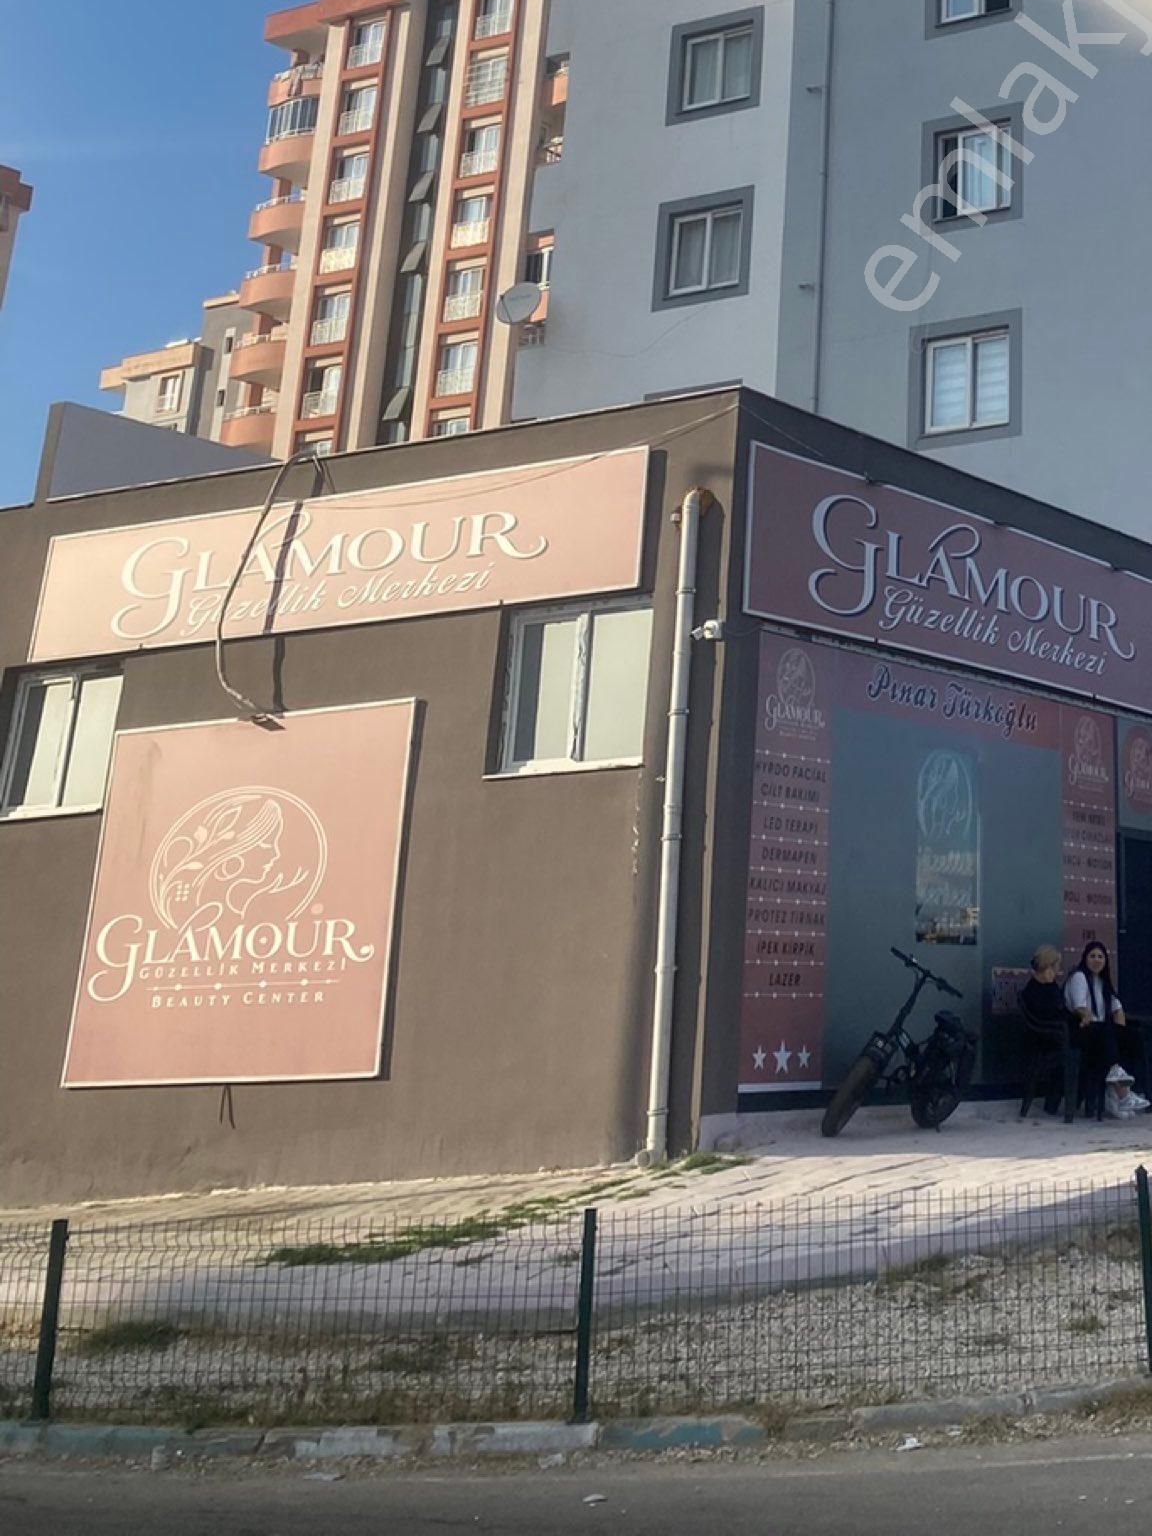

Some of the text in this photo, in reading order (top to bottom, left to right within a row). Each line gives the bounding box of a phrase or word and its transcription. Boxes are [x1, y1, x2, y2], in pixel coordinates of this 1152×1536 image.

[111, 511, 548, 639] GLAMOUR
[338, 563, 495, 609] Merkezi
[808, 494, 1135, 659] GLAMOUR
[879, 586, 1108, 676] Güzellik Merkezi
[867, 664, 1037, 739] Pınar Türkoğlu
[763, 816, 783, 832] LED
[761, 847, 817, 864] DERMAPEN
[749, 877, 826, 896] KALICI MAKYAJ
[748, 908, 825, 926] PROTEZ TIRNAK
[88, 901, 374, 1001] GLAMOUR
[768, 972, 801, 987] LAZER
[152, 991, 323, 1008] BEAUTY CENTER
